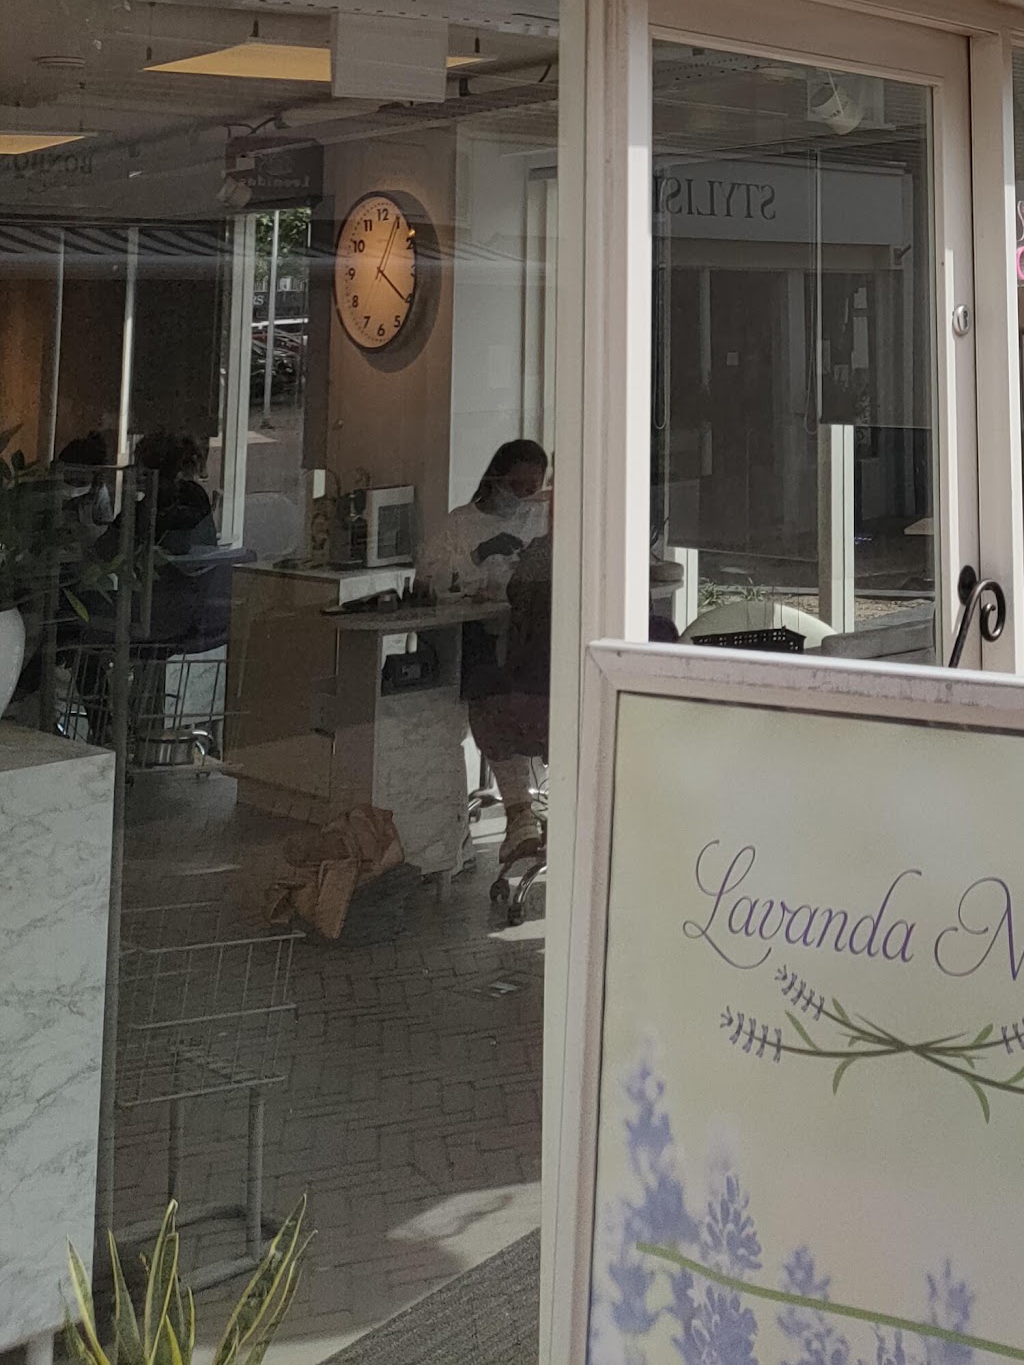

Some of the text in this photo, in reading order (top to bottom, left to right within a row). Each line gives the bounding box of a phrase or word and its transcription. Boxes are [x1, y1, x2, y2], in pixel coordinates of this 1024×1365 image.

[377, 208, 388, 222] 12
[363, 219, 373, 232] 11
[353, 240, 365, 253] 10
[348, 268, 356, 280] 9
[352, 295, 359, 308] 8
[364, 316, 371, 329] 7
[394, 315, 401, 328] 5
[377, 324, 385, 337] 6
[683, 840, 922, 970] Lavanda
